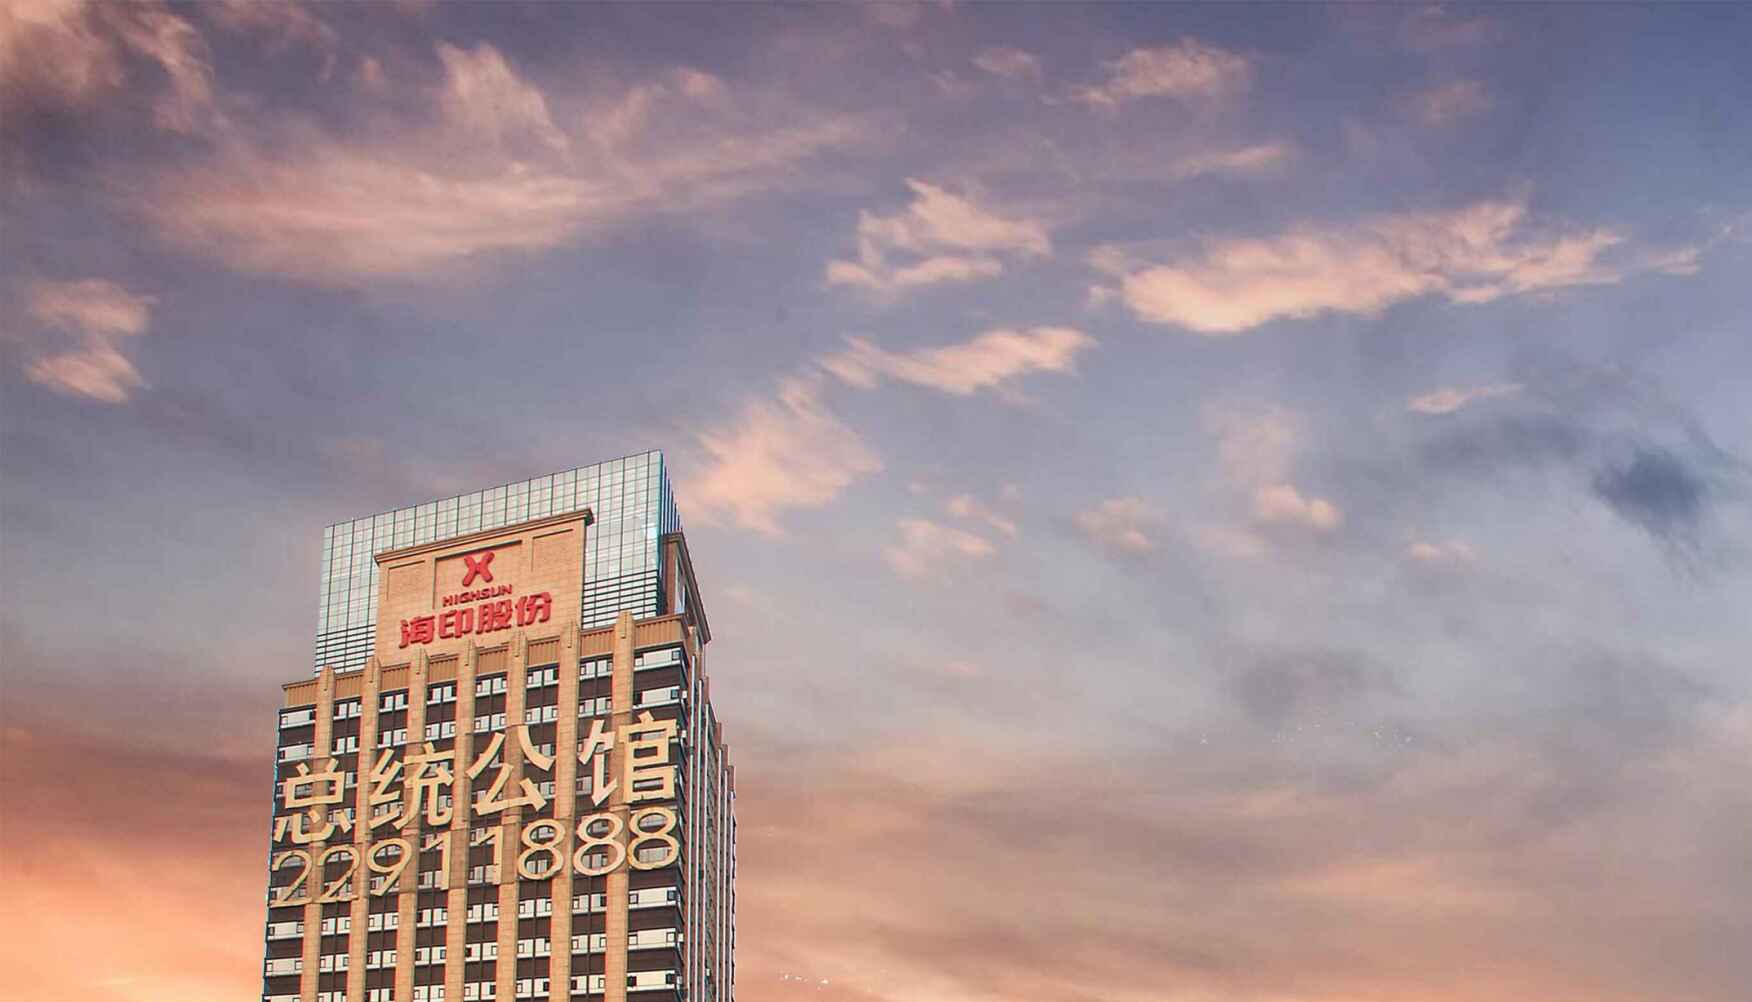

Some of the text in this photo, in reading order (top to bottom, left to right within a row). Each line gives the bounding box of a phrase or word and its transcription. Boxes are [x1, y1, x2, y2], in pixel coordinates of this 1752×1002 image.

[399, 591, 553, 649] 海印股份
[442, 584, 513, 608] HIGHSUN
[272, 710, 678, 845] 总统公馆
[268, 806, 680, 908] 22911888
